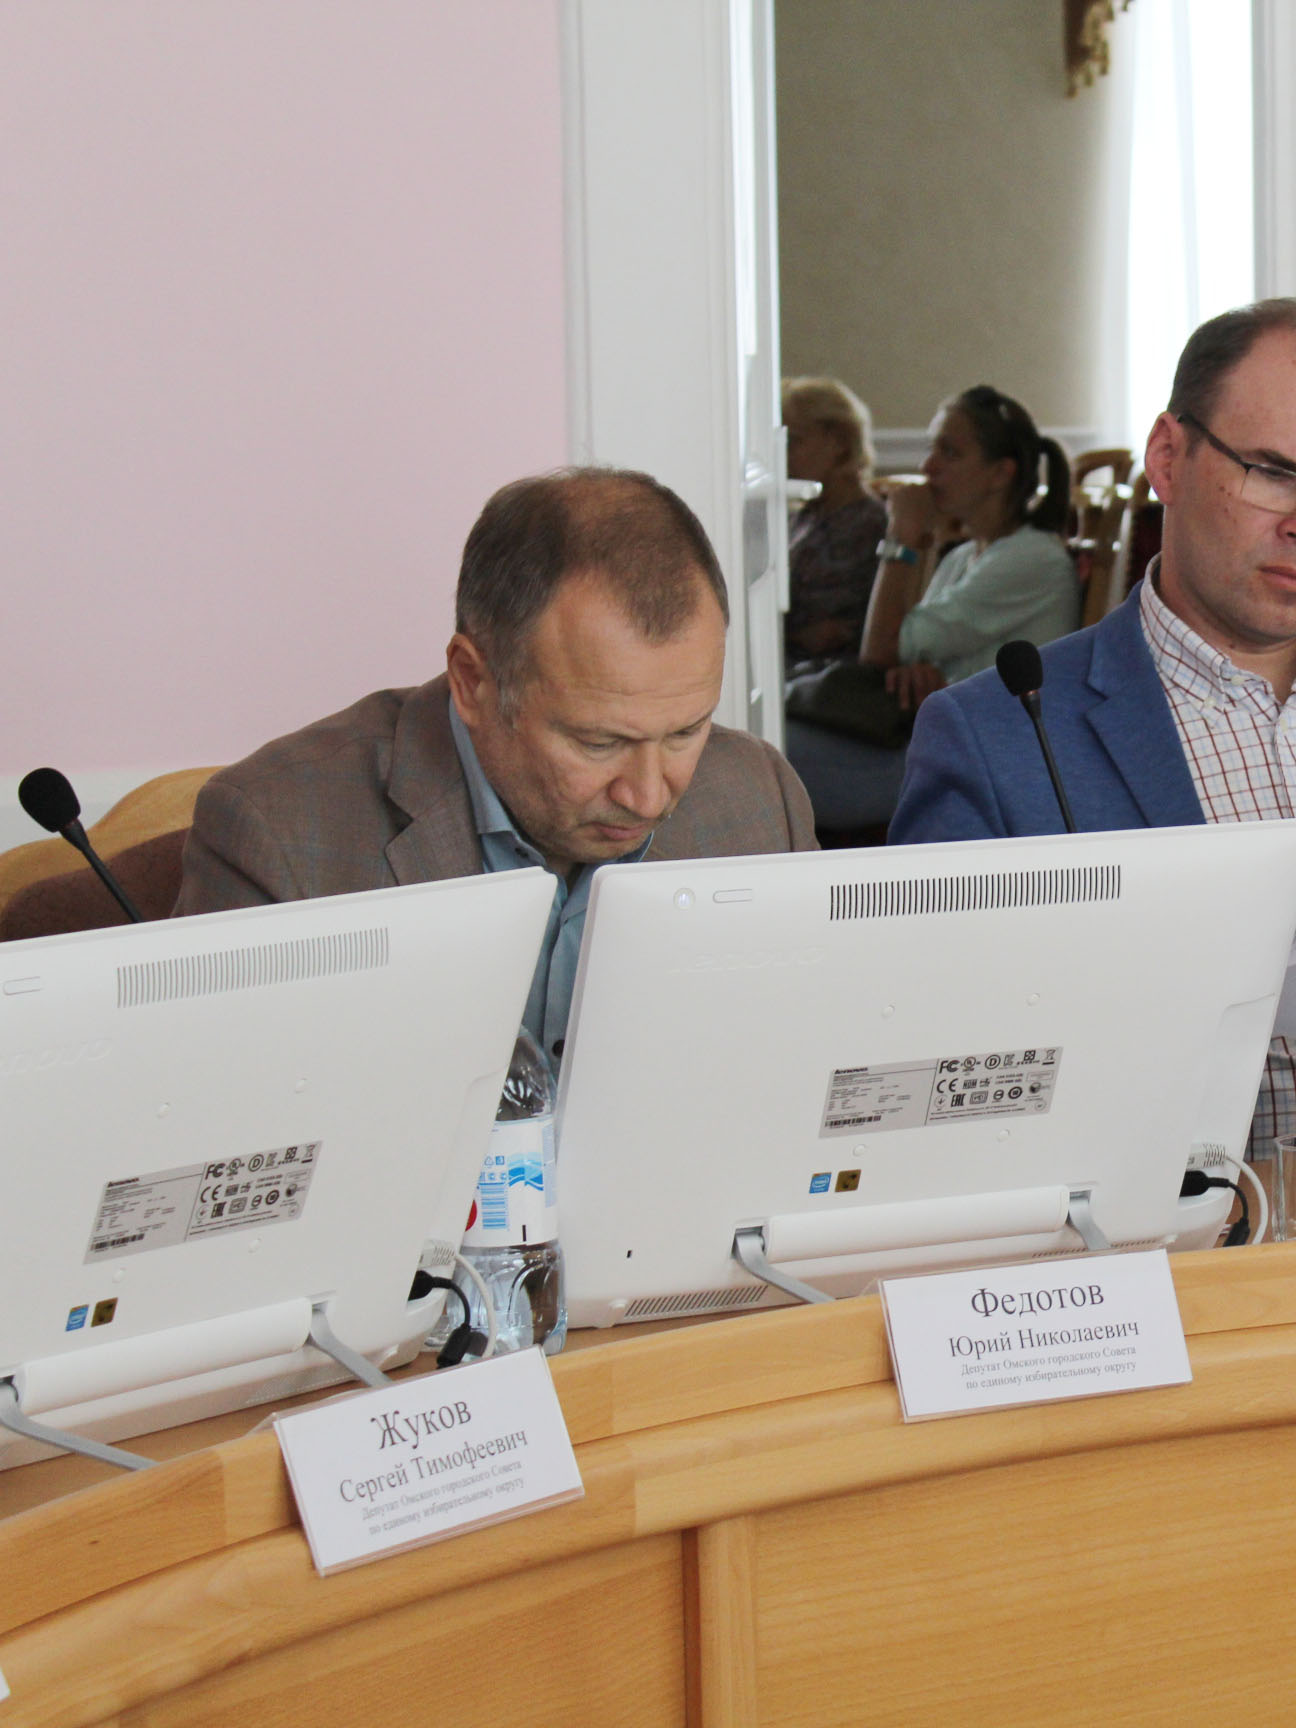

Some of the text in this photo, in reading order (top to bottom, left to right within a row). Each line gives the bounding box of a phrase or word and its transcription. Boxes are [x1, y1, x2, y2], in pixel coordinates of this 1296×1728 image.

[971, 1283, 1105, 1318] Федотов
[948, 1321, 1140, 1360] Юрий Николаевич
[960, 1344, 1136, 1376] Депутат Омского городского Совета
[966, 1359, 1137, 1390] по единому избирательному округу
[370, 1401, 472, 1450] Жуков
[339, 1429, 528, 1502] Сергей Тимофеевич
[362, 1460, 522, 1521] Депутат Омского городского Совета
[368, 1475, 525, 1537] по единому избирательному округу
